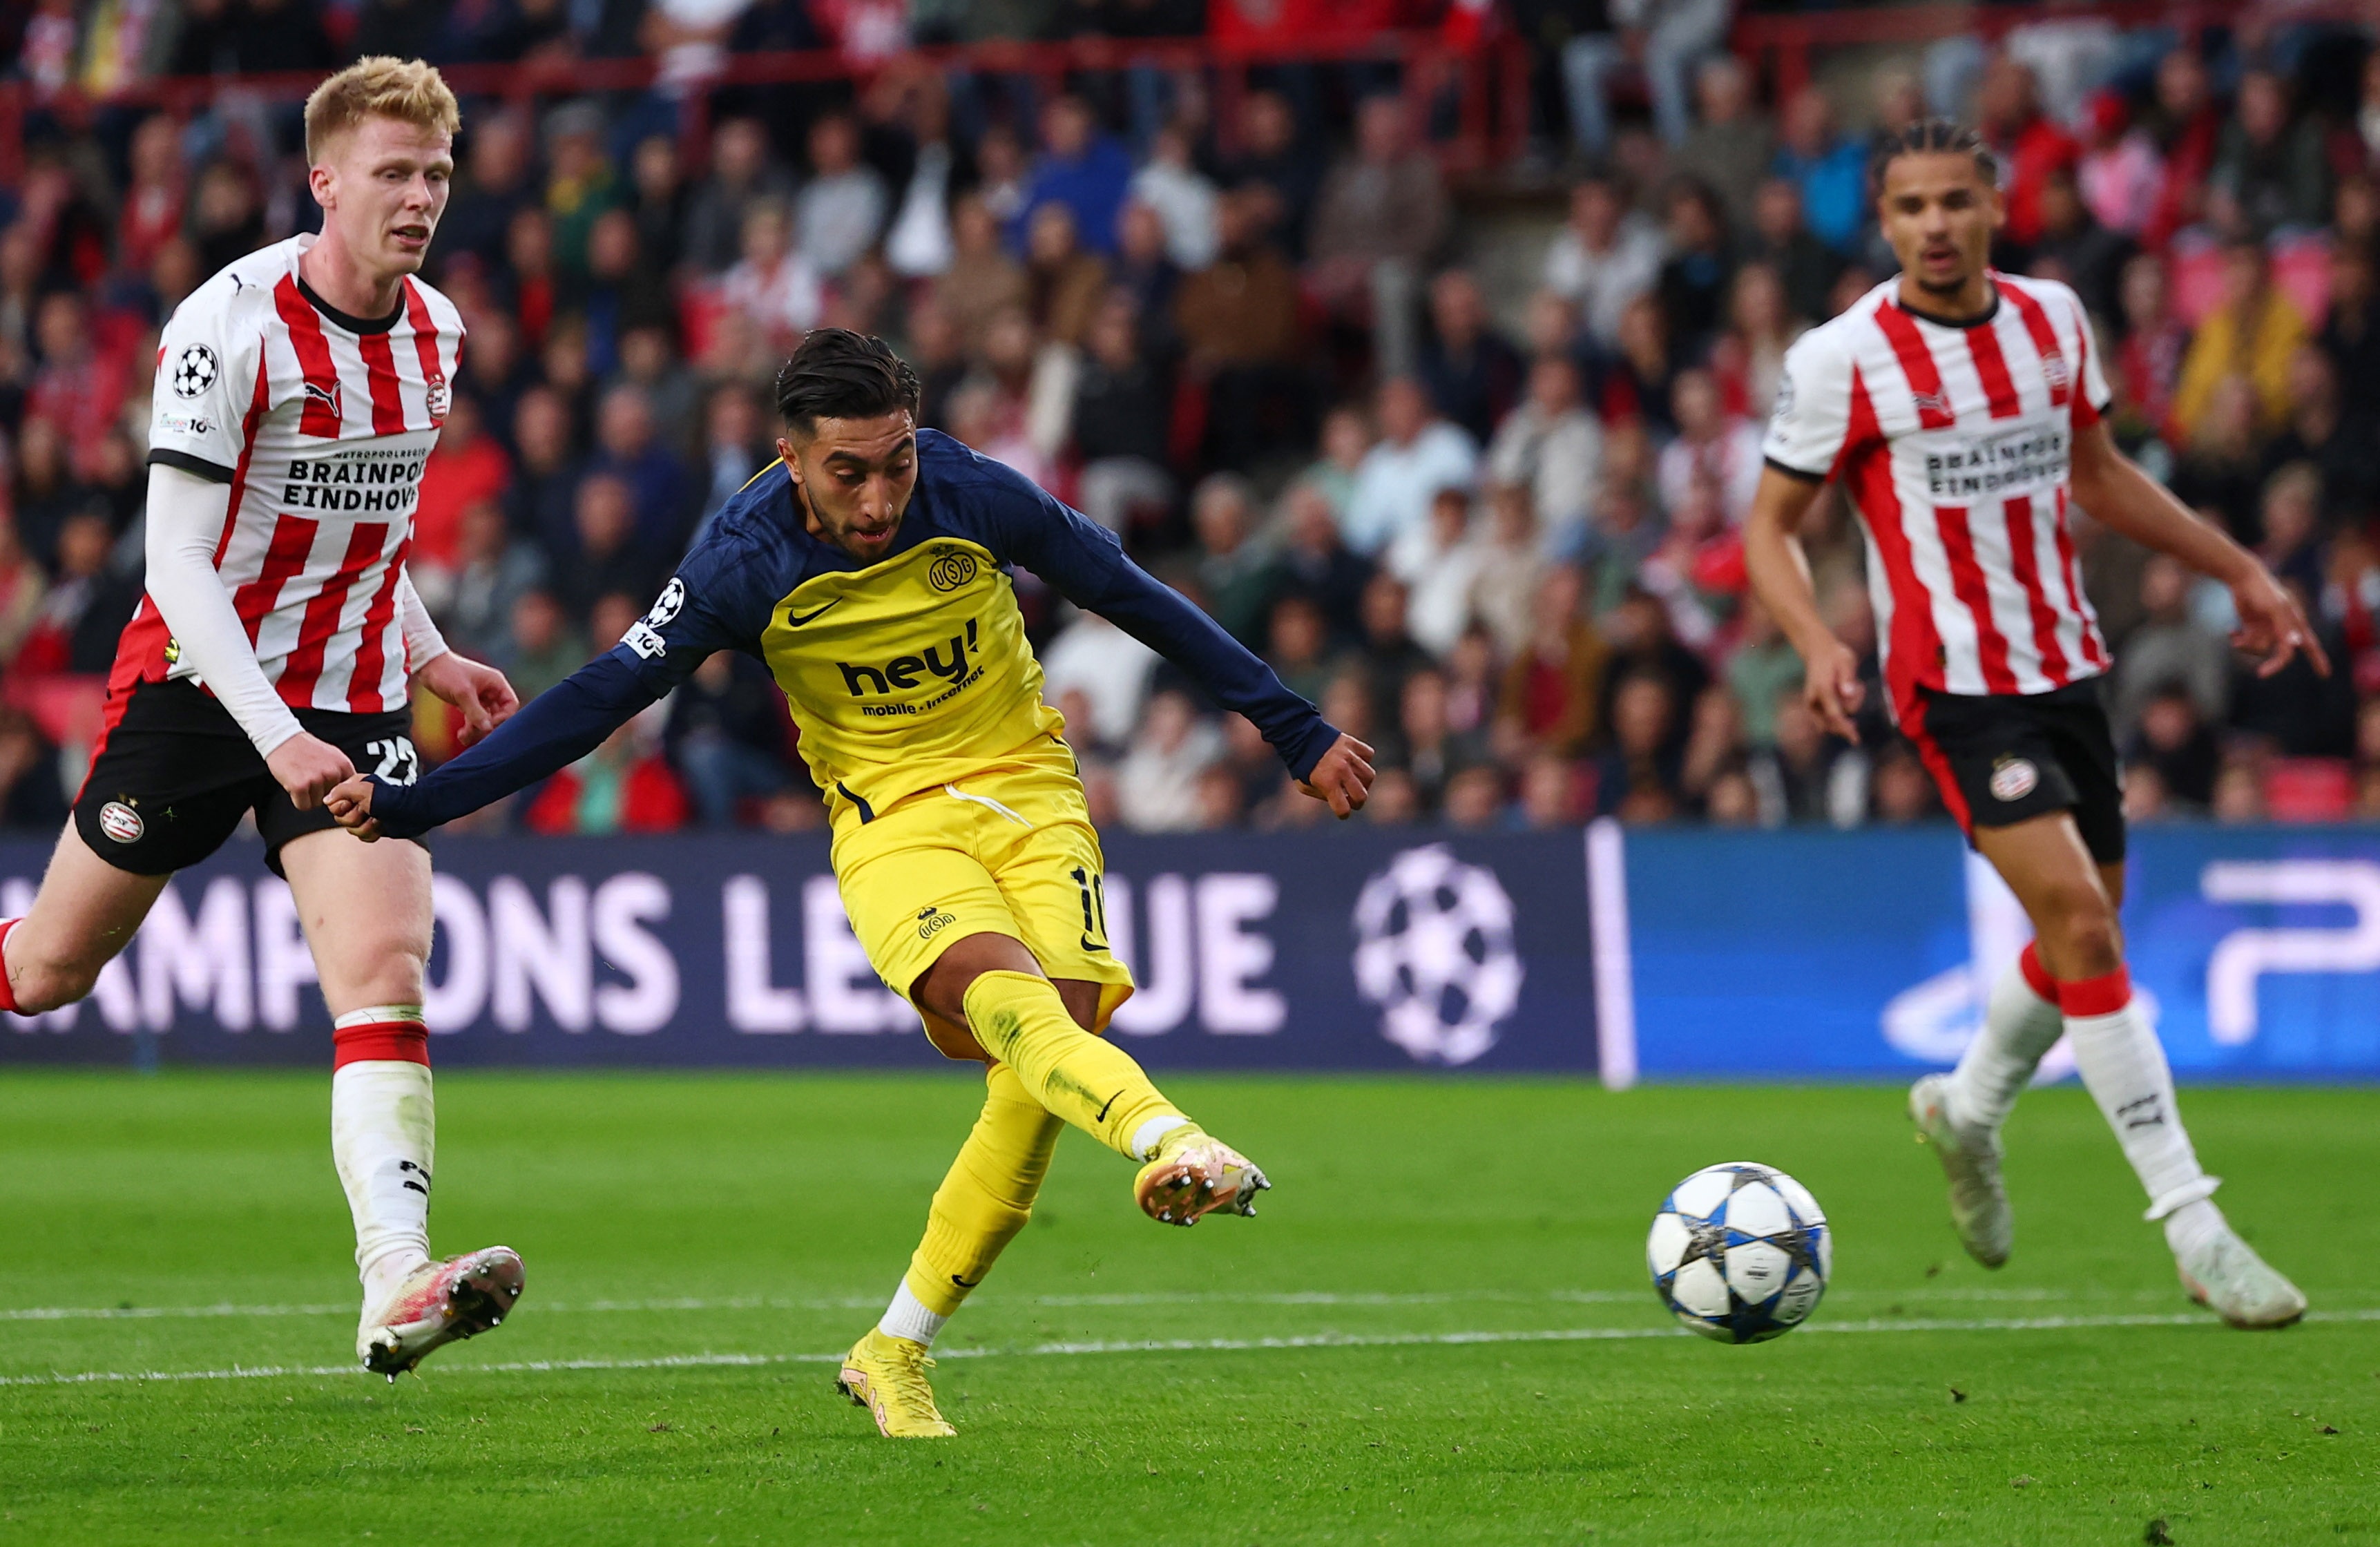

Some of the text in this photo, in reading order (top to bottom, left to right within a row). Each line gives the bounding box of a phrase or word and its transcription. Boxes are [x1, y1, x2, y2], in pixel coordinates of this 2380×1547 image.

[289, 459, 425, 483] BRAINPO
[283, 484, 417, 510] EINDHOV
[932, 557, 972, 586] USG
[835, 617, 979, 697] hey!
[862, 704, 917, 716] mobile
[921, 915, 952, 936] USG
[722, 872, 1289, 1036] LEUE
